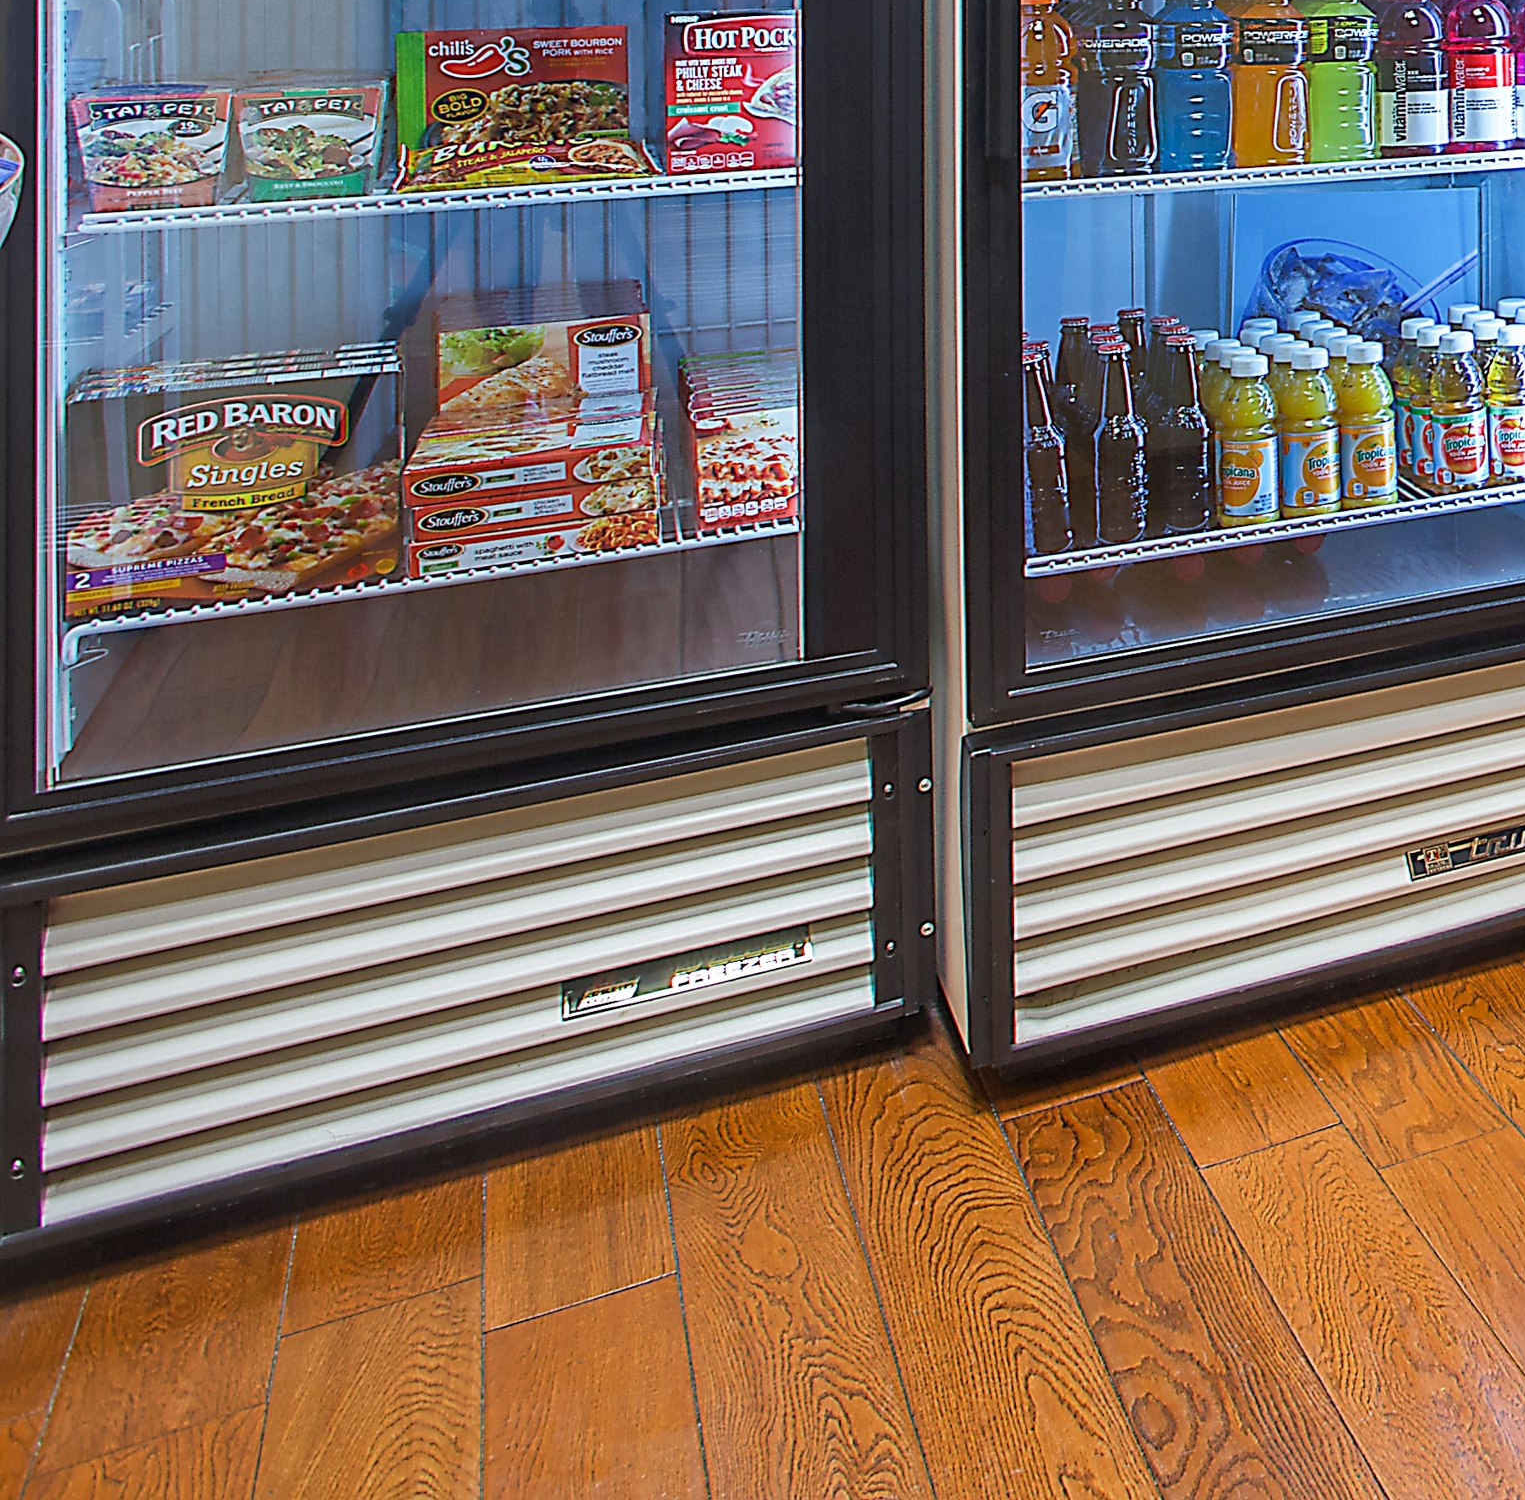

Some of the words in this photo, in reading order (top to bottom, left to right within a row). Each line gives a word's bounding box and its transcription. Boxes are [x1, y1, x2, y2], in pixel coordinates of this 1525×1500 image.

[429, 39, 474, 58] chili's
[533, 40, 567, 48] SWEET
[570, 37, 622, 47] BOURBON
[543, 48, 571, 56] PORK
[676, 65, 708, 79] PHILLY
[711, 64, 743, 78] STEAK
[687, 78, 722, 91] CHEESE
[259, 101, 295, 114] TAI
[313, 100, 350, 111] PEI
[438, 100, 481, 116] BOLD
[1393, 60, 1407, 142] vitaminwater
[104, 105, 141, 118] TAI
[162, 103, 202, 116] PEI
[581, 326, 634, 344] Stouffer's
[151, 412, 217, 448] RED
[223, 403, 337, 429] BARON
[186, 459, 303, 488] Singles
[419, 475, 473, 495] Stouffer's
[192, 494, 248, 509] French
[251, 487, 296, 505] Bread
[426, 509, 479, 528] Stouffer's
[111, 561, 163, 574] SUPREME
[165, 556, 204, 566] PIZZAS
[74, 574, 90, 589] 2
